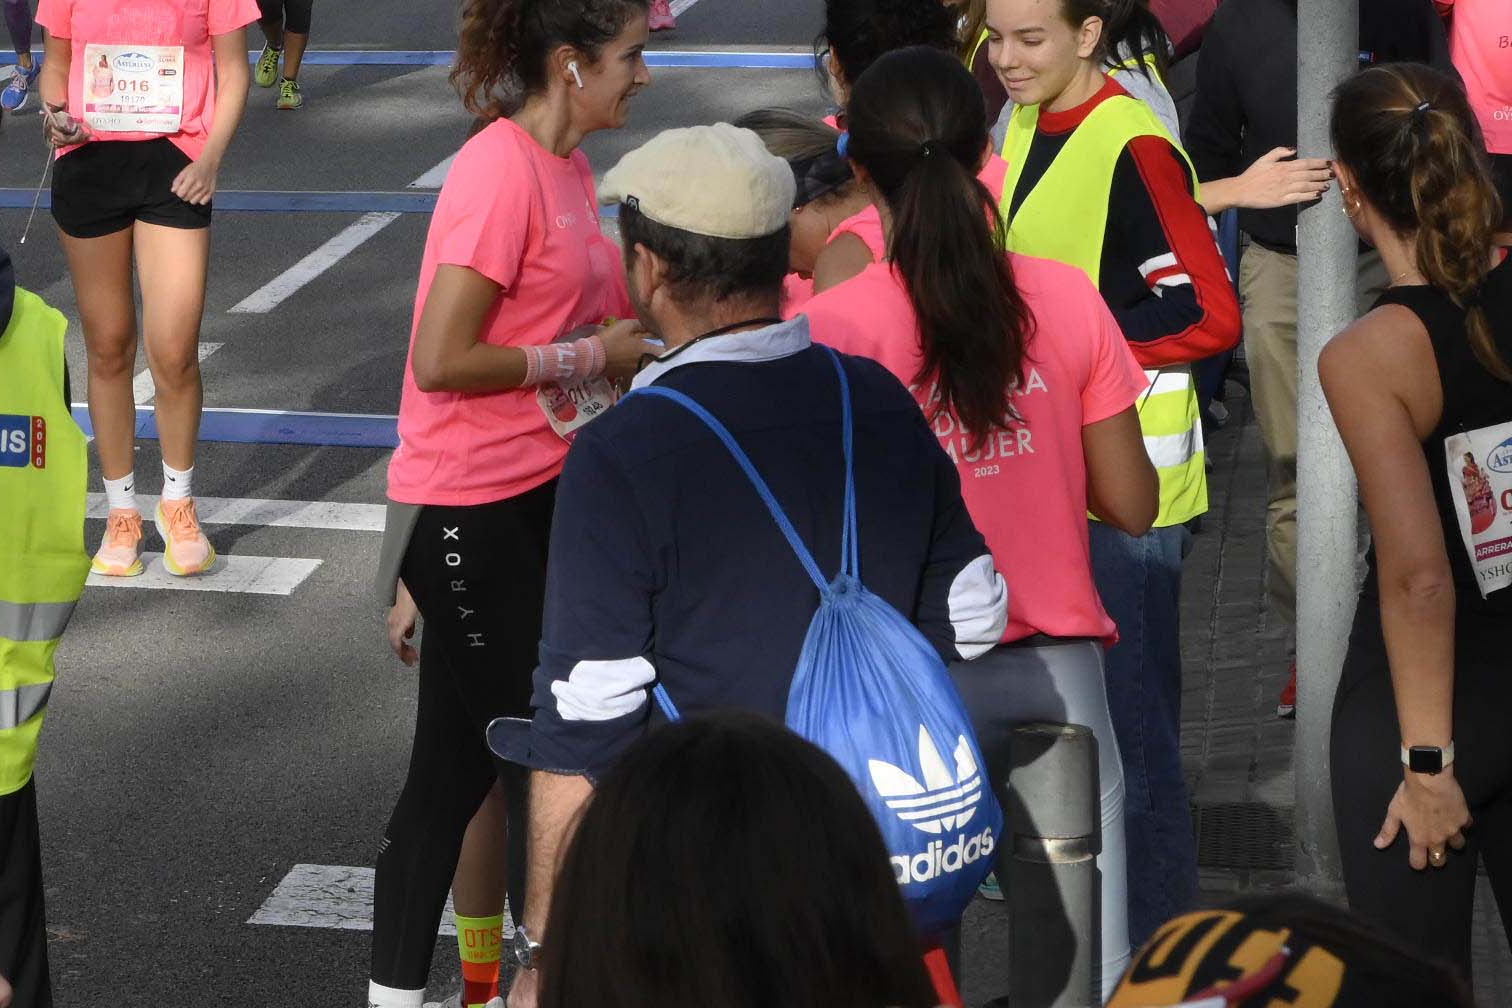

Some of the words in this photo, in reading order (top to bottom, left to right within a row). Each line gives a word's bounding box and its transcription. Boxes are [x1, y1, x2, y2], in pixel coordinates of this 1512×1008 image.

[117, 78, 150, 92] 016
[35, 419, 43, 467] 2000
[974, 465, 1000, 478] 2023
[443, 526, 485, 647] HYROX
[890, 827, 994, 884] adidas
